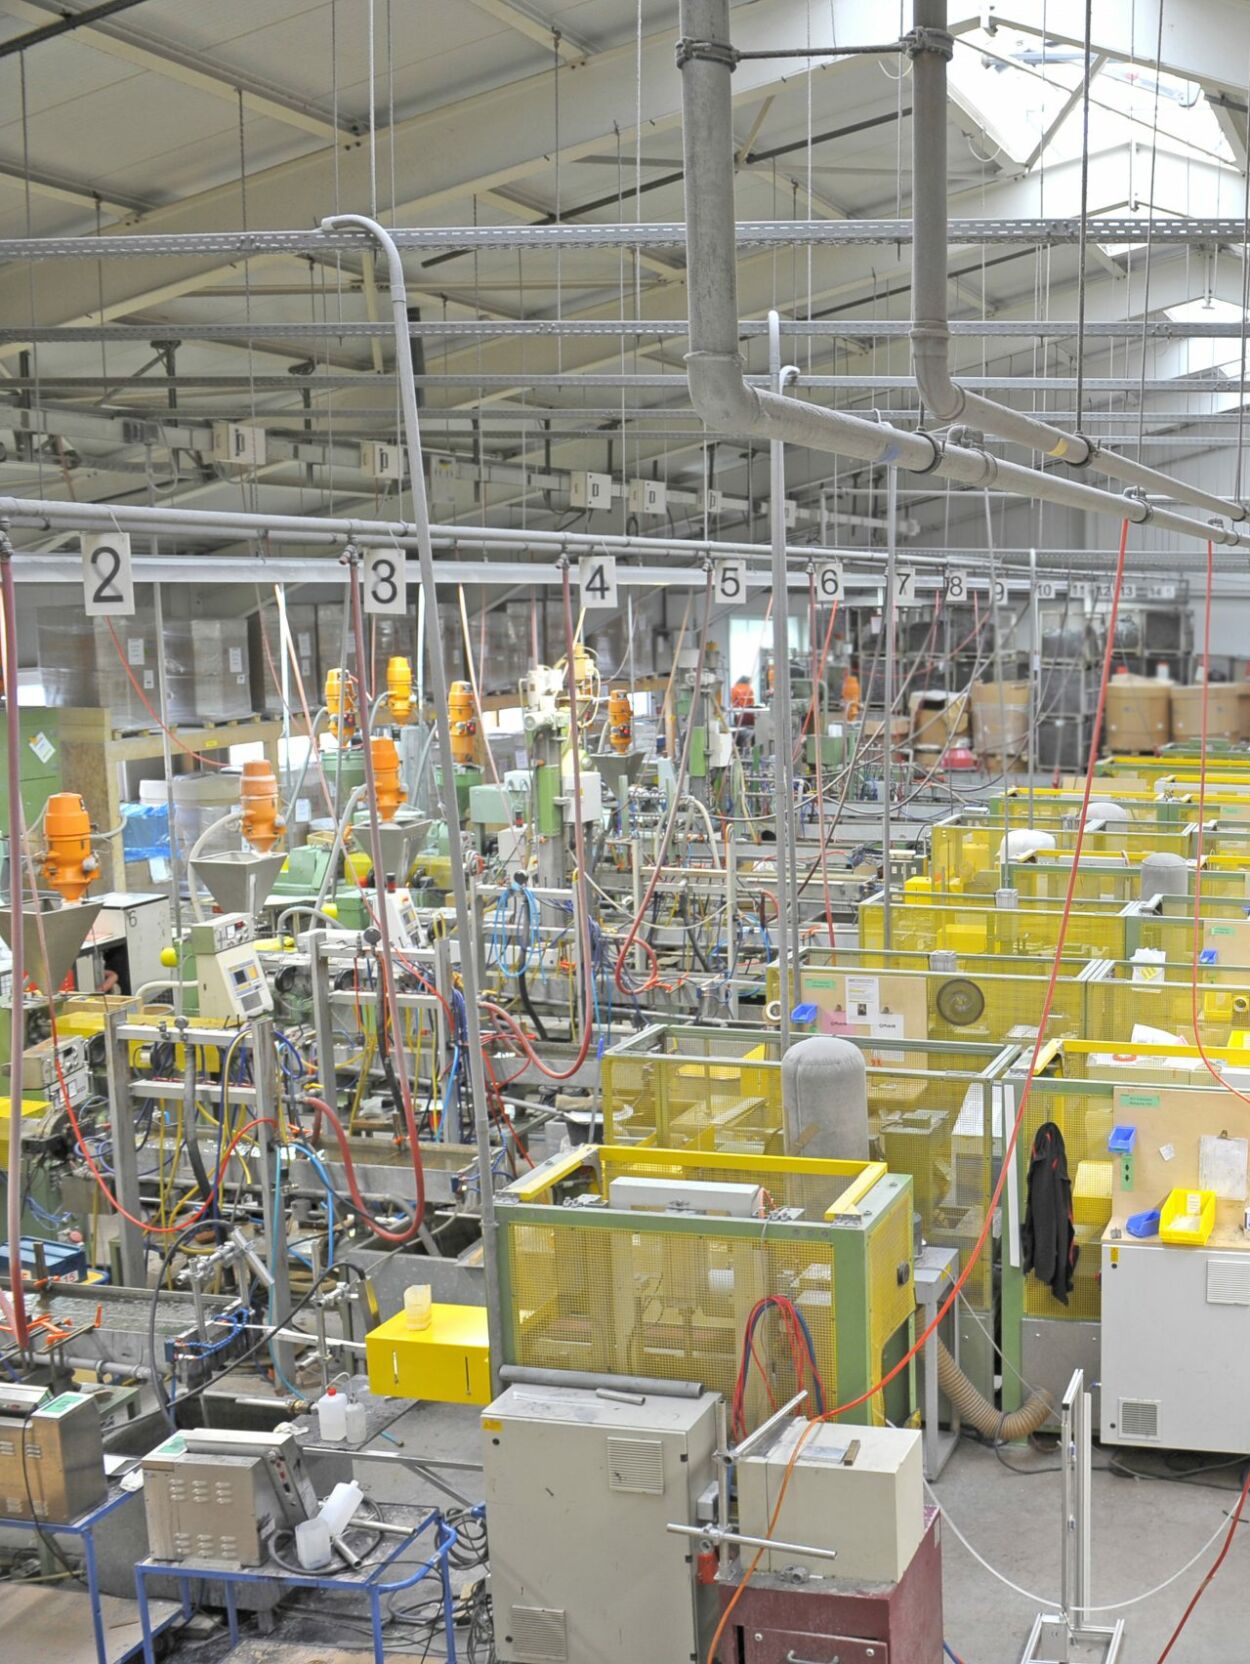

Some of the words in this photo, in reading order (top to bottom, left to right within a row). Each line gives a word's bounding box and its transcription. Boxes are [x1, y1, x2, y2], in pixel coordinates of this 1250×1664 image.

[91, 546, 124, 603] 2
[371, 559, 398, 604] 3
[585, 564, 610, 600] 4
[721, 567, 740, 597] 5
[821, 569, 838, 595] 6
[896, 573, 911, 595] 7
[950, 576, 963, 596] 8
[994, 582, 1004, 602] 9
[1038, 583, 1052, 597] 10
